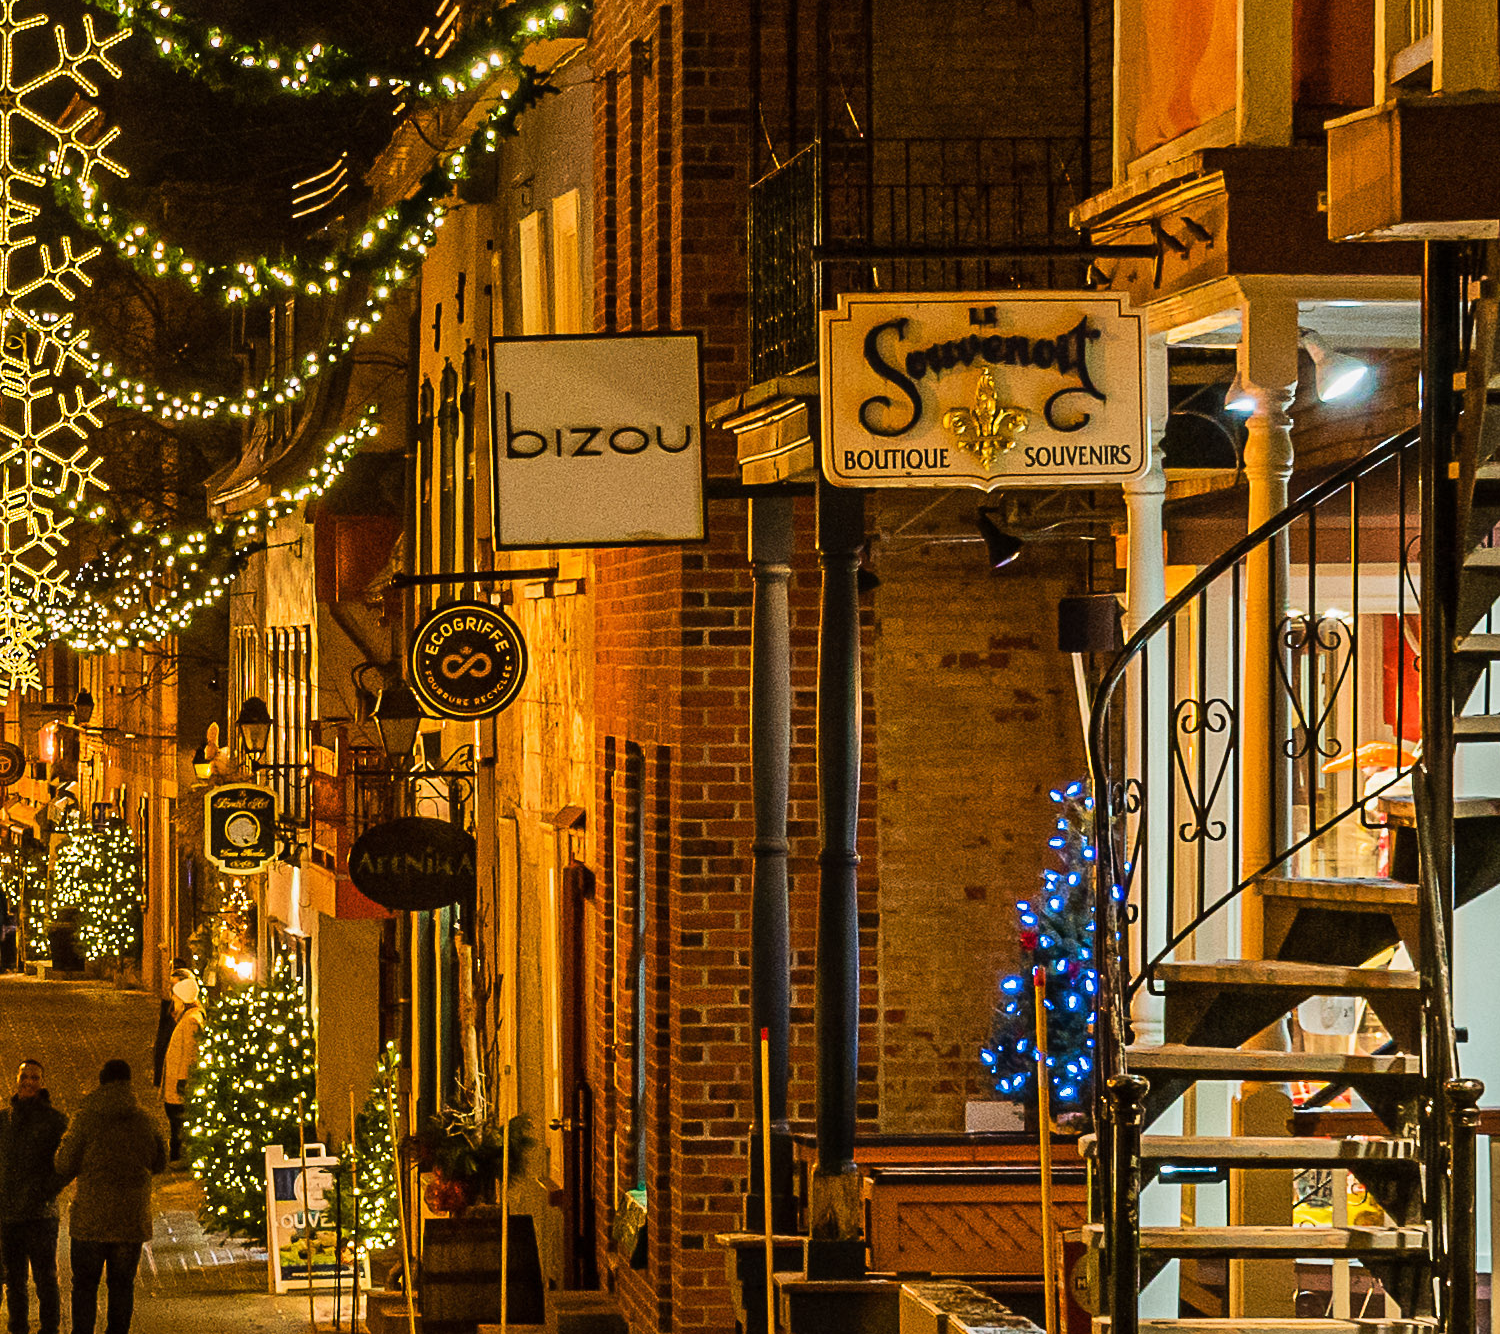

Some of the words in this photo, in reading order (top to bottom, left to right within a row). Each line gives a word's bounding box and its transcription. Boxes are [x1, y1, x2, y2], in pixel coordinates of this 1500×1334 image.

[969, 306, 997, 327] LE
[505, 391, 691, 459] bizou
[844, 449, 950, 470] BOUTIQUE
[1025, 445, 1131, 467] SOUVENIRS
[425, 617, 509, 655] ECOGRIFFE
[425, 670, 469, 706] FOURRURE
